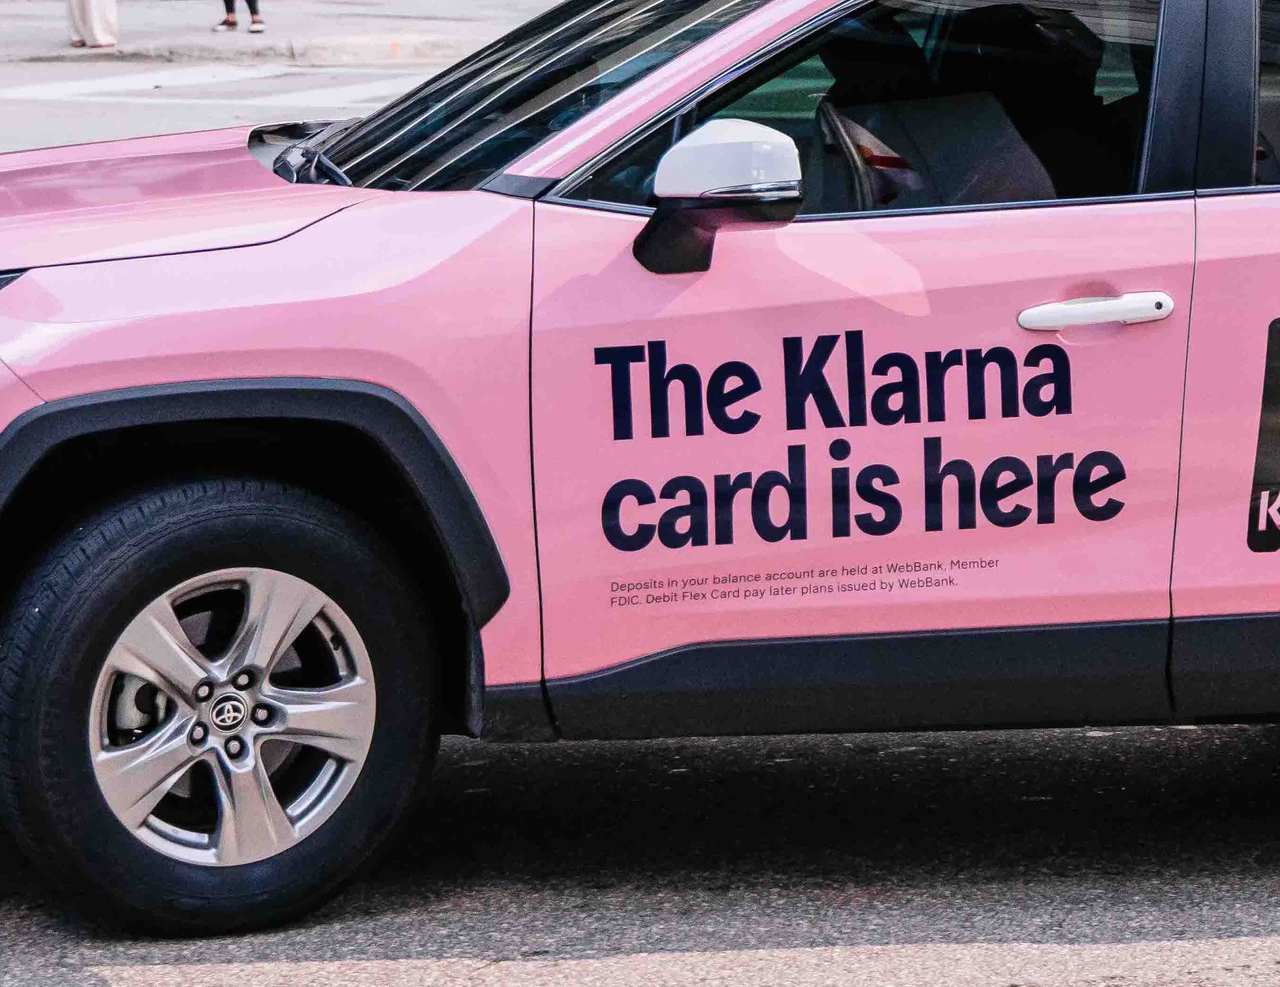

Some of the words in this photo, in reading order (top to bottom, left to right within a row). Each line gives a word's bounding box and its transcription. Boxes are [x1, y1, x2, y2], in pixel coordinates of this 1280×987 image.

[594, 340, 762, 441] The
[783, 330, 1072, 431] Klarna
[601, 444, 808, 552] card
[829, 438, 903, 538] is
[924, 436, 1127, 532] here
[610, 579, 664, 594] Deposits
[667, 577, 678, 589] in
[681, 577, 709, 589] your
[713, 573, 761, 585] balance
[765, 570, 814, 581] account
[818, 567, 838, 578] are
[841, 565, 868, 577] held
[871, 565, 883, 575] at
[886, 560, 947, 574] WebBank,
[950, 558, 1000, 571] Member
[610, 595, 643, 607] FDIC.
[646, 592, 678, 604] Debit
[682, 591, 707, 601] Flex
[710, 588, 740, 599] Card
[743, 587, 766, 599] pay
[769, 584, 797, 596] later
[801, 583, 834, 596] plans
[837, 581, 876, 593] issued
[880, 578, 895, 592] by
[898, 575, 959, 589] WebBank.
